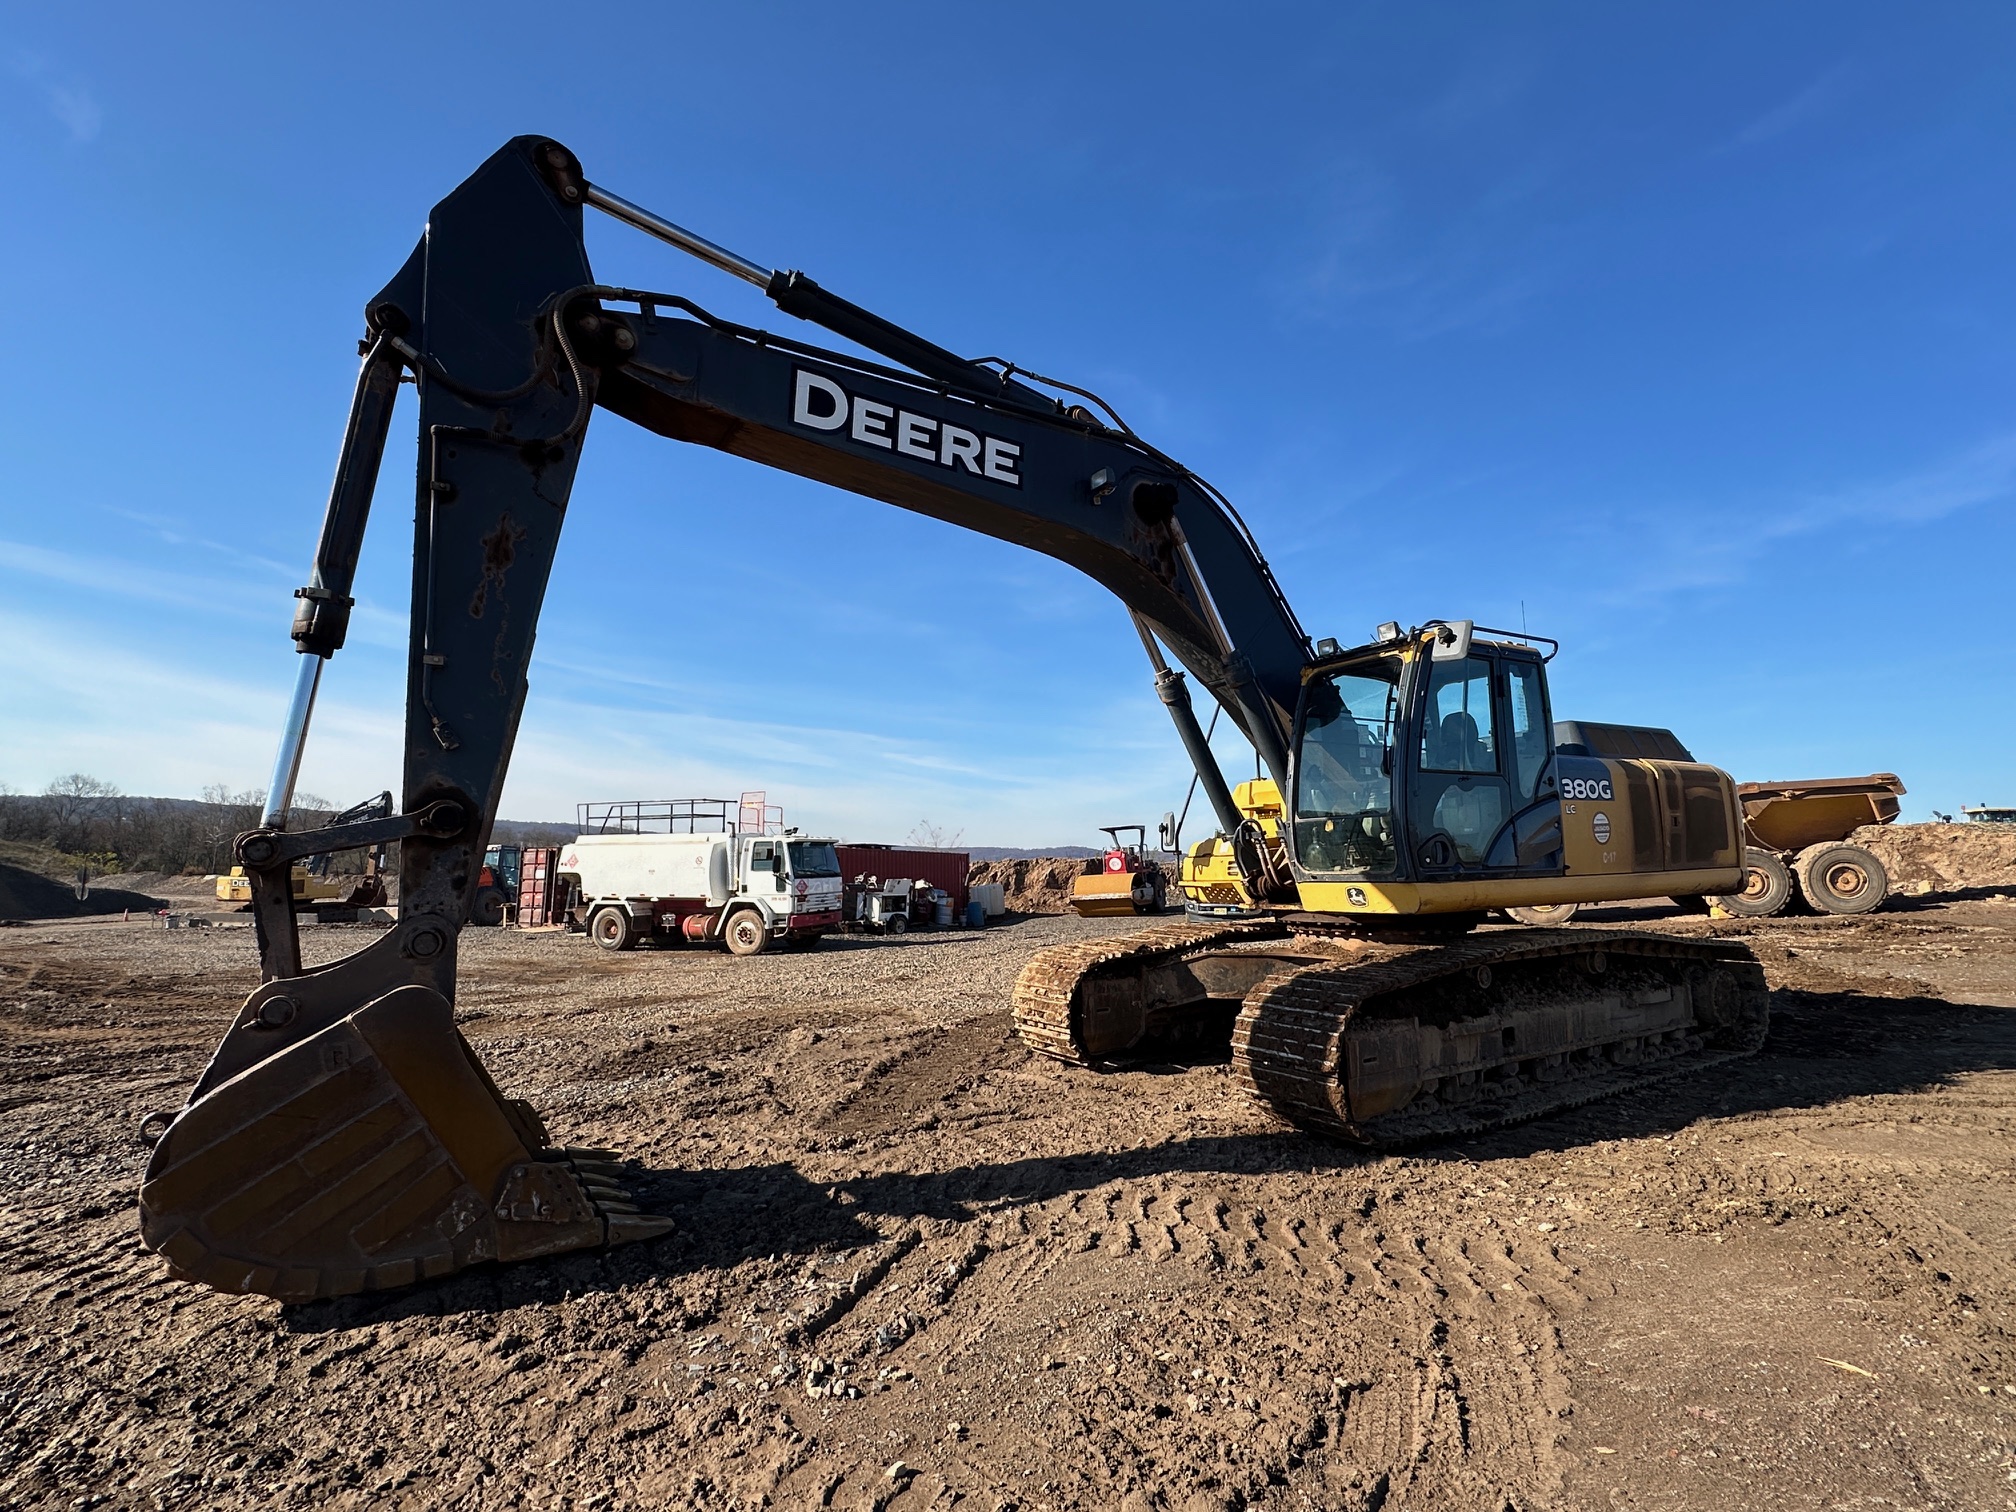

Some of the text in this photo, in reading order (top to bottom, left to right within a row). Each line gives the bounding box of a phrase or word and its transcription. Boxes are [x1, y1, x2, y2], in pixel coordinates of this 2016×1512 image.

[794, 369, 1020, 485] DEERE
[1561, 778, 1612, 799] 380G
[1565, 804, 1577, 814] LC
